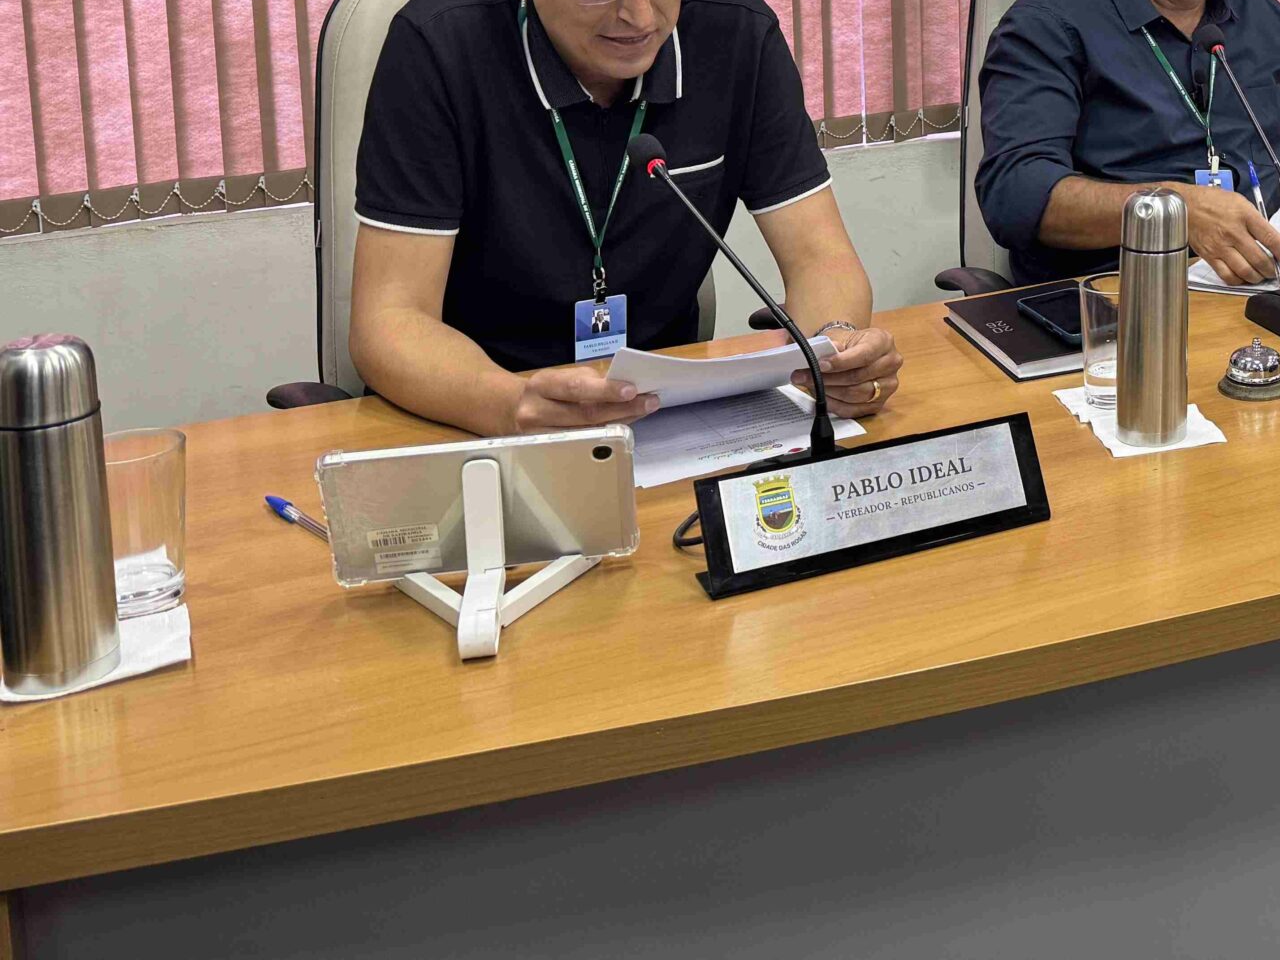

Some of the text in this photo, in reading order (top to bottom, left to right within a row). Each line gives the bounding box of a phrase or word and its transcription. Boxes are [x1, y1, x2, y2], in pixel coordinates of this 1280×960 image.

[832, 457, 972, 502] PABLO IDEAL
[837, 481, 975, 520] VEREADOR REPUBLICANOS
[757, 540, 778, 551] CIDADE
[790, 530, 807, 547] ROSAS
